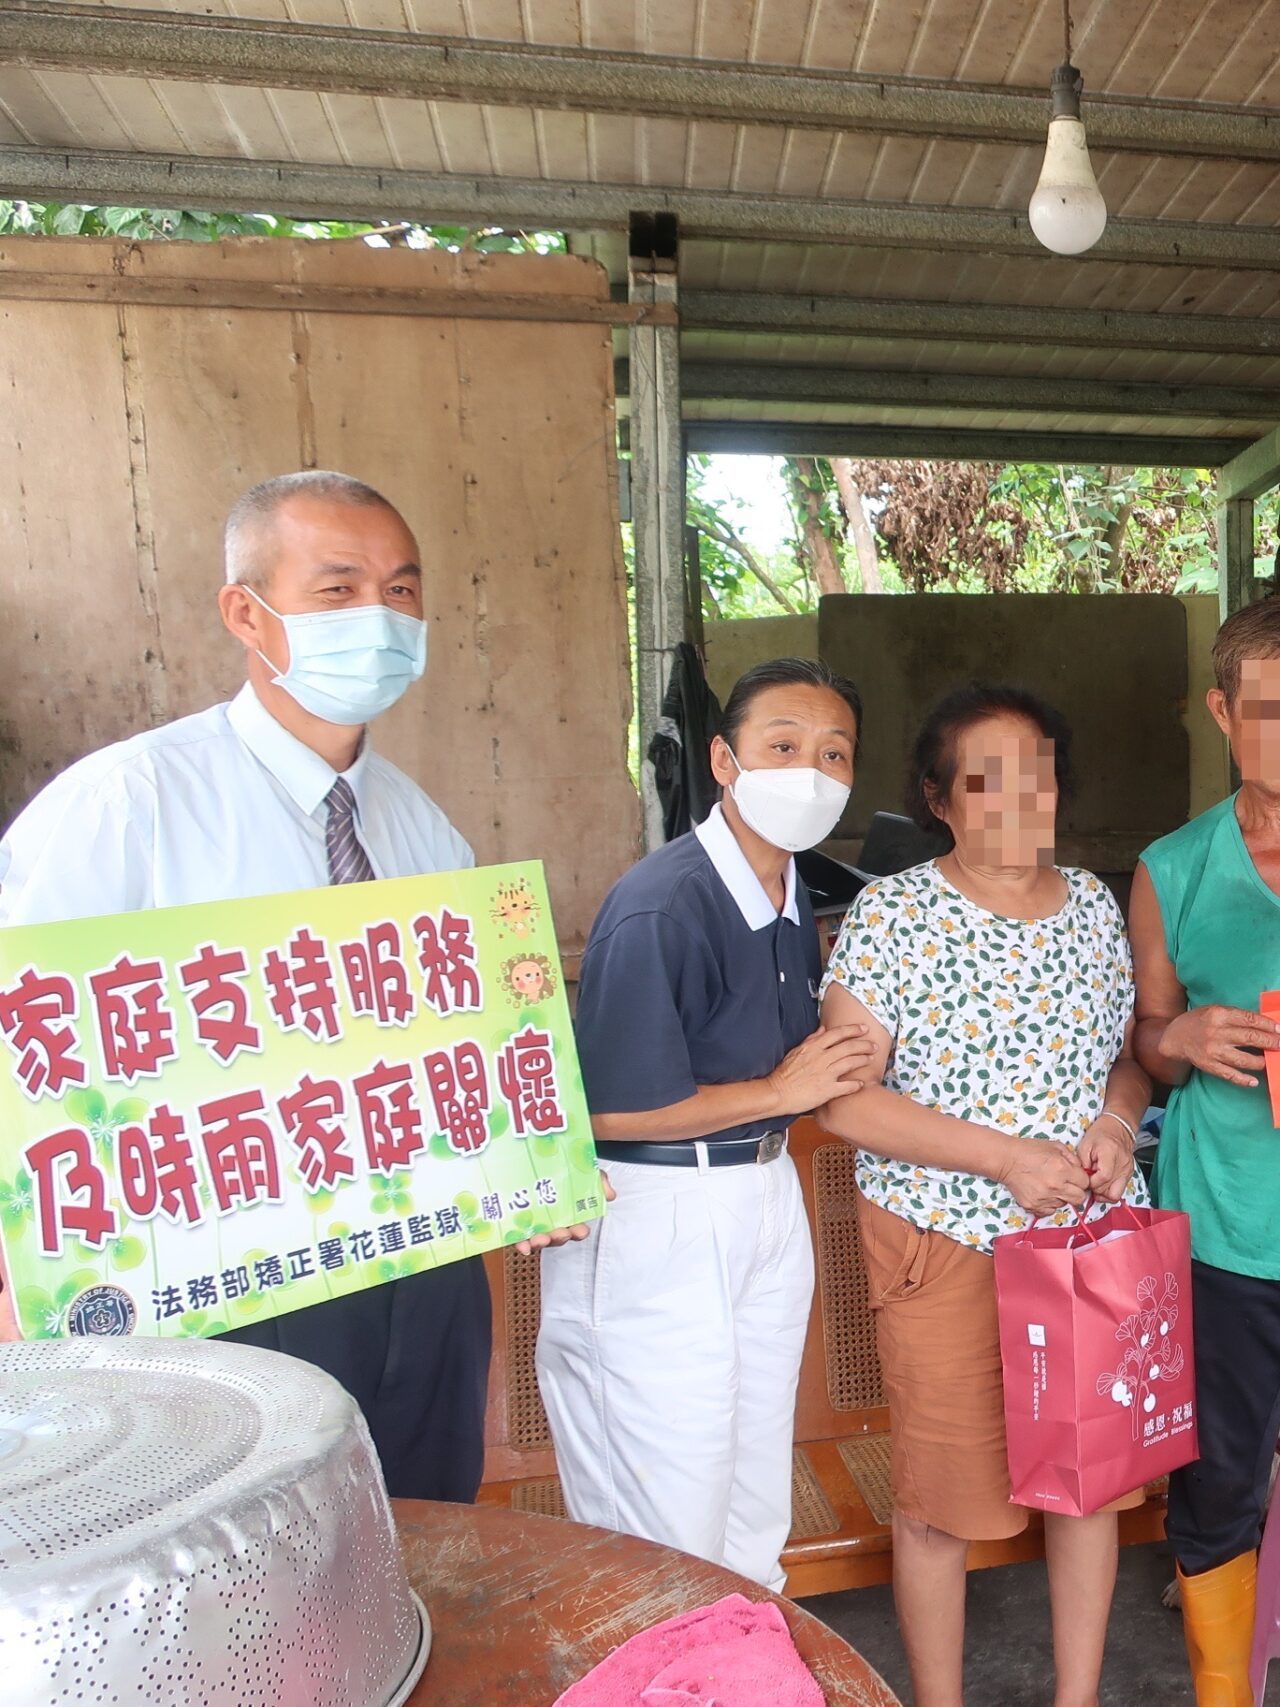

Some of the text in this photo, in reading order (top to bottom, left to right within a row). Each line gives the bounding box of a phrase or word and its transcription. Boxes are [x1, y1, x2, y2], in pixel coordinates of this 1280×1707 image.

[0, 909, 483, 1095] 家庭支持服務
[24, 1028, 566, 1254] 及時雨家庭關懷
[151, 1179, 557, 1322] 法務部矯正署花蓮監獄 關心您
[1143, 1432, 1169, 1448] Gratitude
